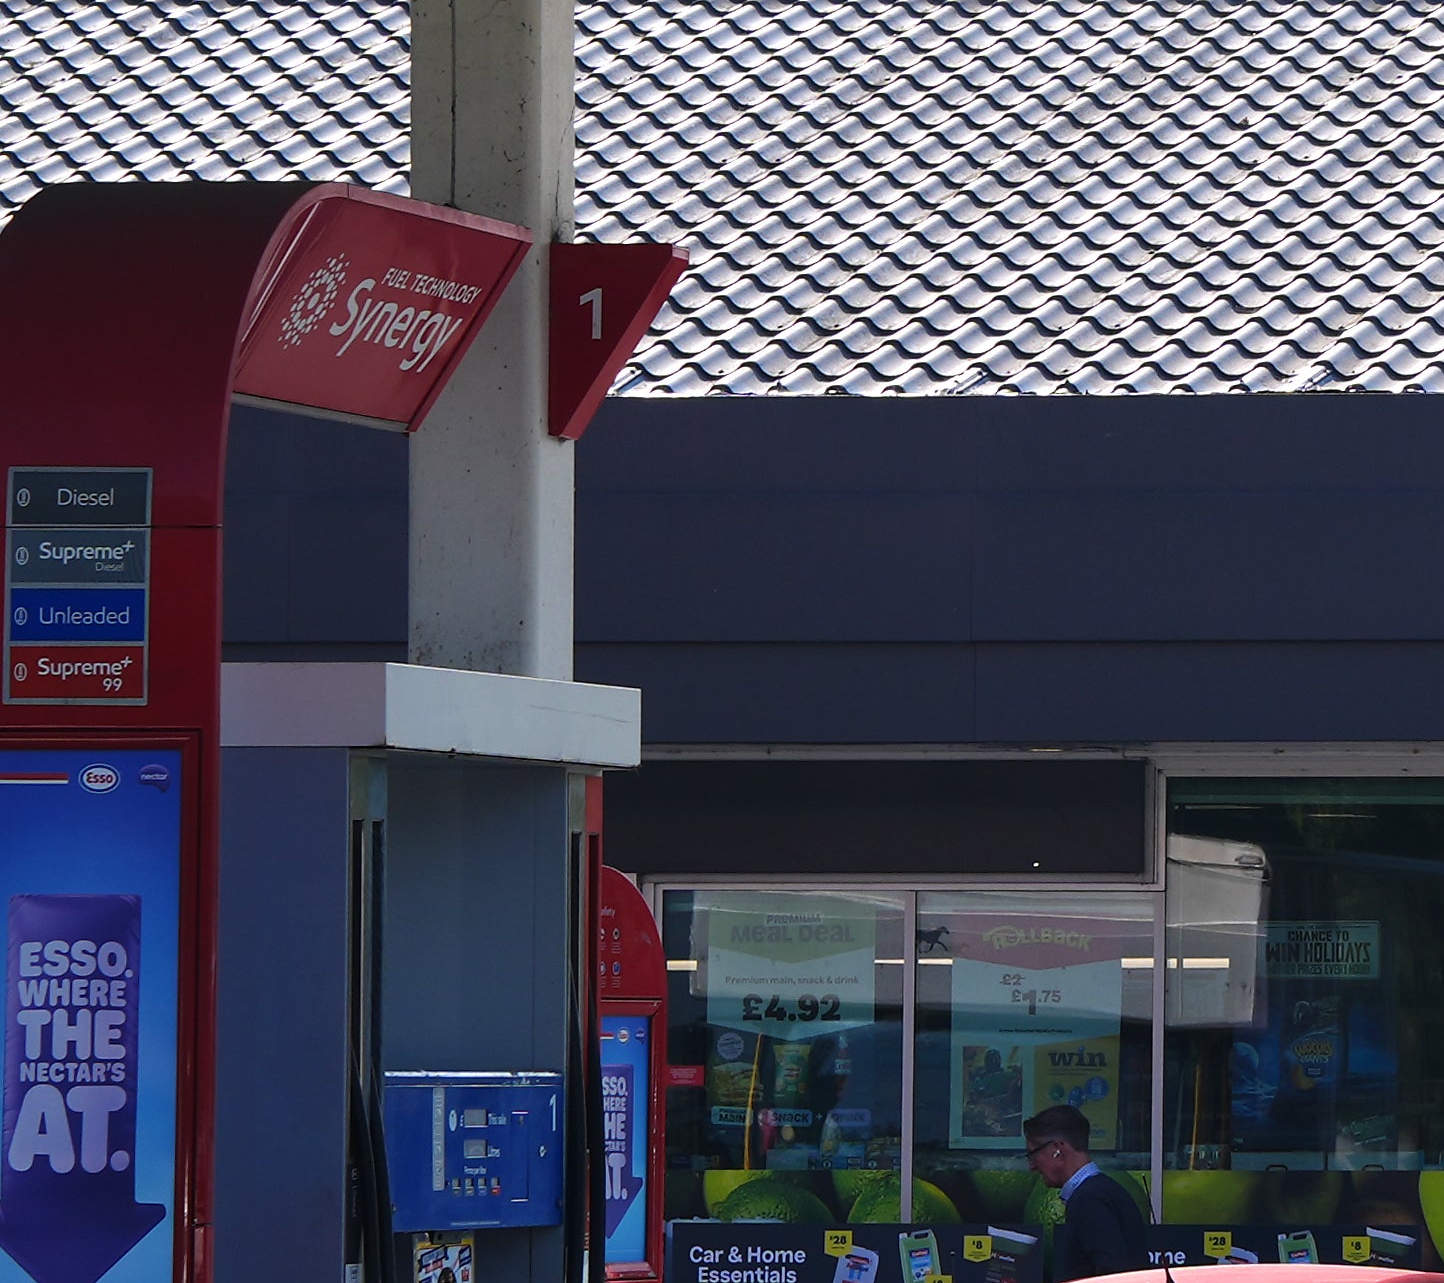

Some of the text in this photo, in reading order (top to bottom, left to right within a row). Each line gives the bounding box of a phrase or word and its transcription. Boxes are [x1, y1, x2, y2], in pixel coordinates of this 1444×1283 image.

[381, 267, 482, 304] FUEL TECHNOLOGY
[579, 288, 603, 340] 1
[330, 279, 462, 373] Synergy
[56, 488, 115, 506] Diesel
[95, 562, 125, 572] Diesel
[38, 607, 131, 625] Unleaded
[102, 679, 122, 692] 99
[20, 940, 133, 979] ESSO.
[1304, 942, 1371, 963] HOLIDAYS
[18, 979, 126, 1007] WHERE
[742, 993, 841, 1021] £4.92
[17, 1008, 127, 1062] THE
[1047, 1045, 1108, 1068] win
[19, 1061, 126, 1083] NECTAR'S
[602, 1076, 628, 1097] SSO.
[603, 1097, 626, 1112] HERE
[8, 1085, 131, 1174] AT.
[604, 1112, 626, 1140] HE
[689, 1246, 807, 1264] Car & Home
[697, 1267, 798, 1283] Essentials
